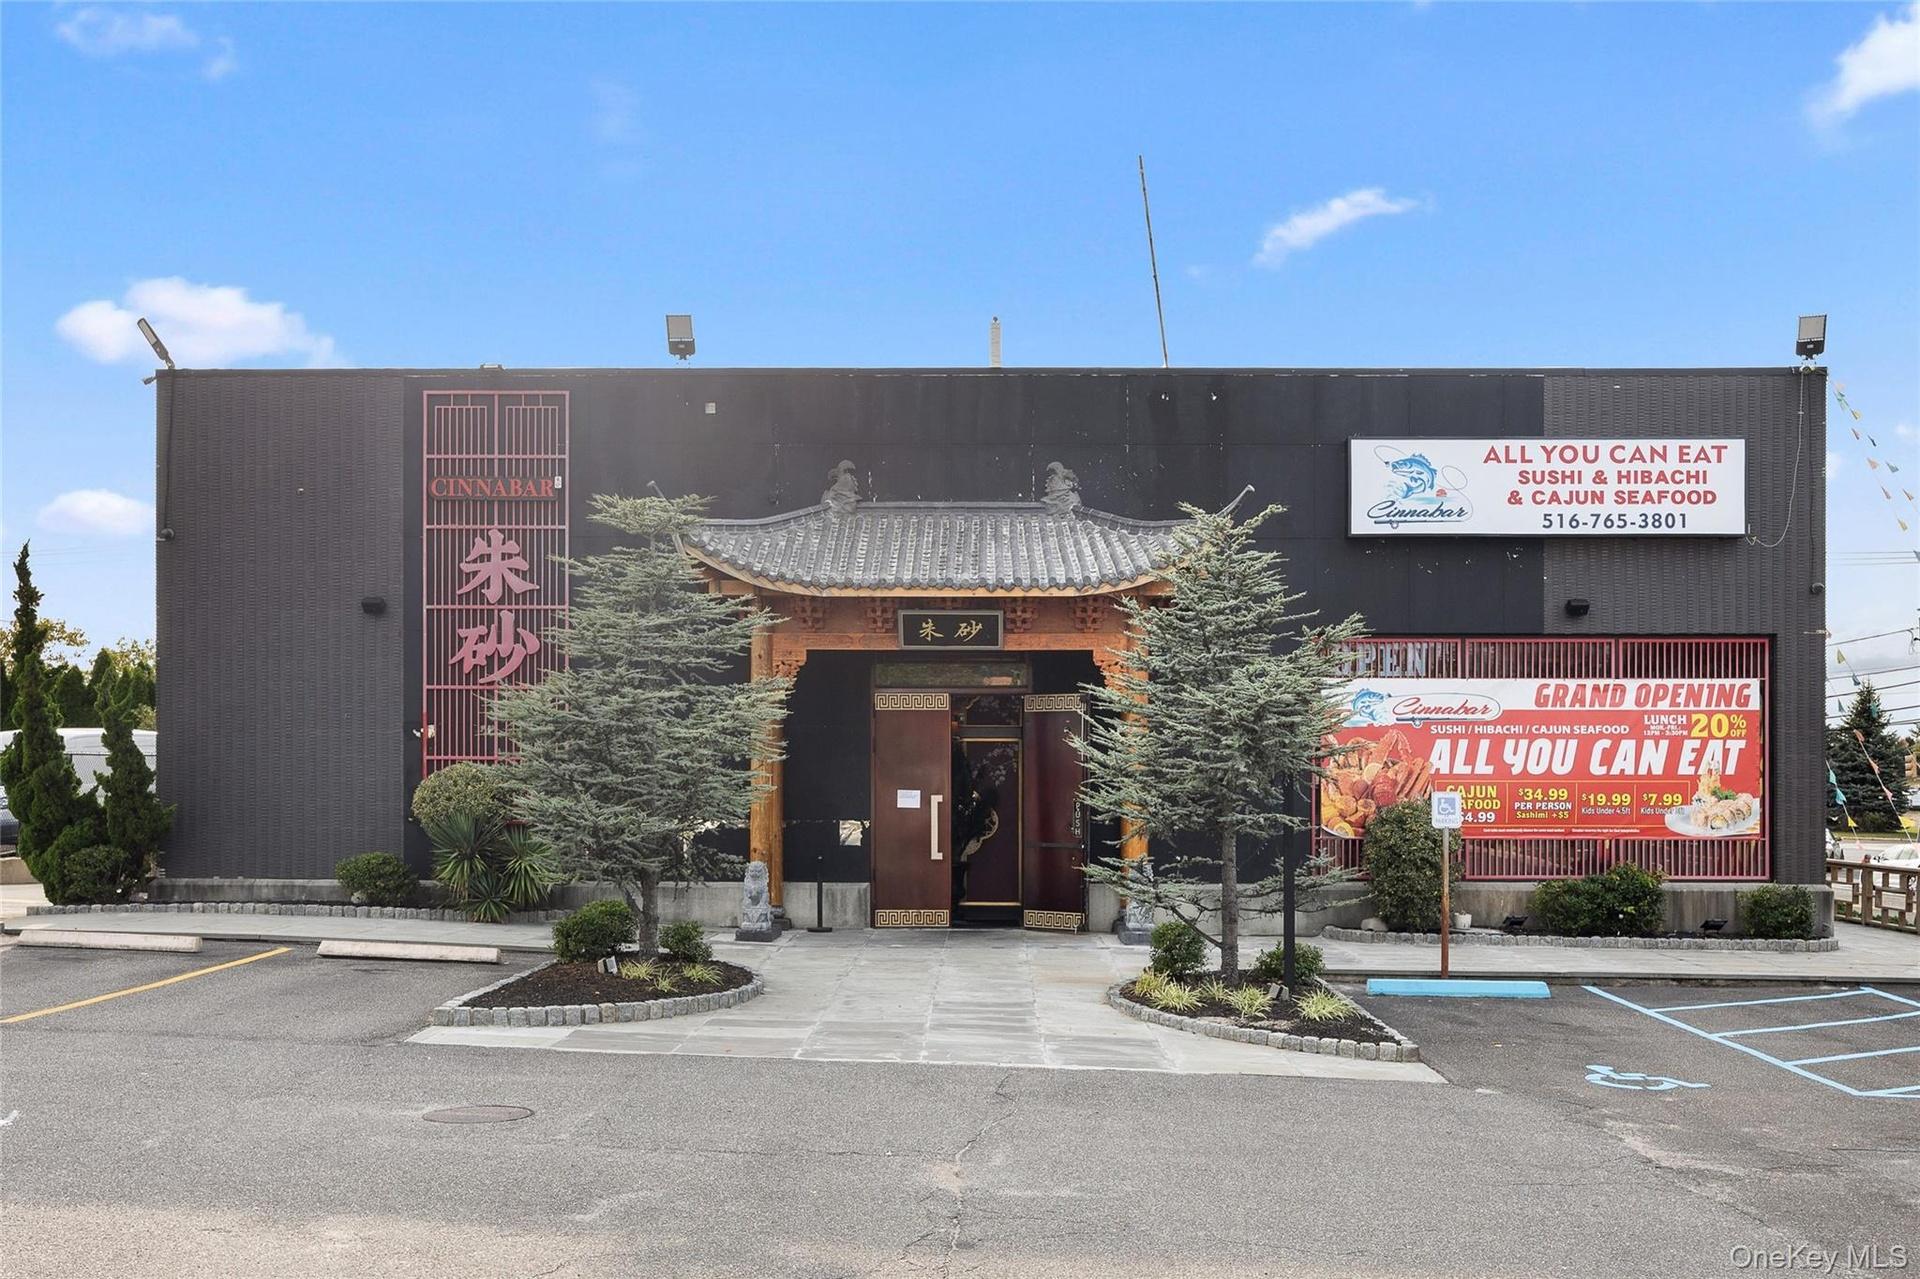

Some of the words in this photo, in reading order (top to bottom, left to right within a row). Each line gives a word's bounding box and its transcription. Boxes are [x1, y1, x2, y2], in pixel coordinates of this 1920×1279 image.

[1483, 445, 1533, 464] ALL
[1540, 445, 1600, 464] YOU
[1609, 445, 1667, 464] CAN
[1679, 445, 1728, 464] EAT
[1518, 469, 1583, 485] SUSHI
[1592, 470, 1608, 485] &
[1617, 469, 1708, 485] HIBACHI
[431, 478, 555, 498] CINNABAR
[1507, 490, 1523, 505] &
[1531, 490, 1605, 505] CAJUN
[1613, 490, 1717, 505] SEAFOOD
[1367, 500, 1468, 519] Cinnabar
[1542, 513, 1687, 529] 516-765-3801
[919, 618, 984, 642] 朱砂
[1535, 683, 1627, 709] GRAND
[1634, 683, 1752, 709] OPENING
[1392, 697, 1492, 716] Cinnabar
[1643, 714, 1687, 725] LUNCH
[1430, 725, 1466, 735] SUSHI
[1474, 725, 1523, 735] HIBACHI
[1532, 725, 1571, 735] CAJUN
[1573, 725, 1630, 735] SEAFOOD
[1730, 729, 1747, 737] OFF
[1428, 738, 1495, 775] ALL
[1503, 738, 1579, 775] YOU
[1589, 738, 1670, 776] CAN
[1677, 739, 1746, 776] EAT
[1518, 788, 1568, 801] $34.99
[1581, 793, 1631, 806] $19.99
[1642, 793, 1683, 806] $7.99
[1461, 799, 1501, 810] AFOOD
[1514, 802, 1533, 810] PER
[1535, 802, 1572, 810] PERSON
[1581, 807, 1595, 815] Kids
[1596, 807, 1615, 815] Under
[1640, 807, 1654, 815] Kids
[1516, 811, 1548, 819] Sashimi
